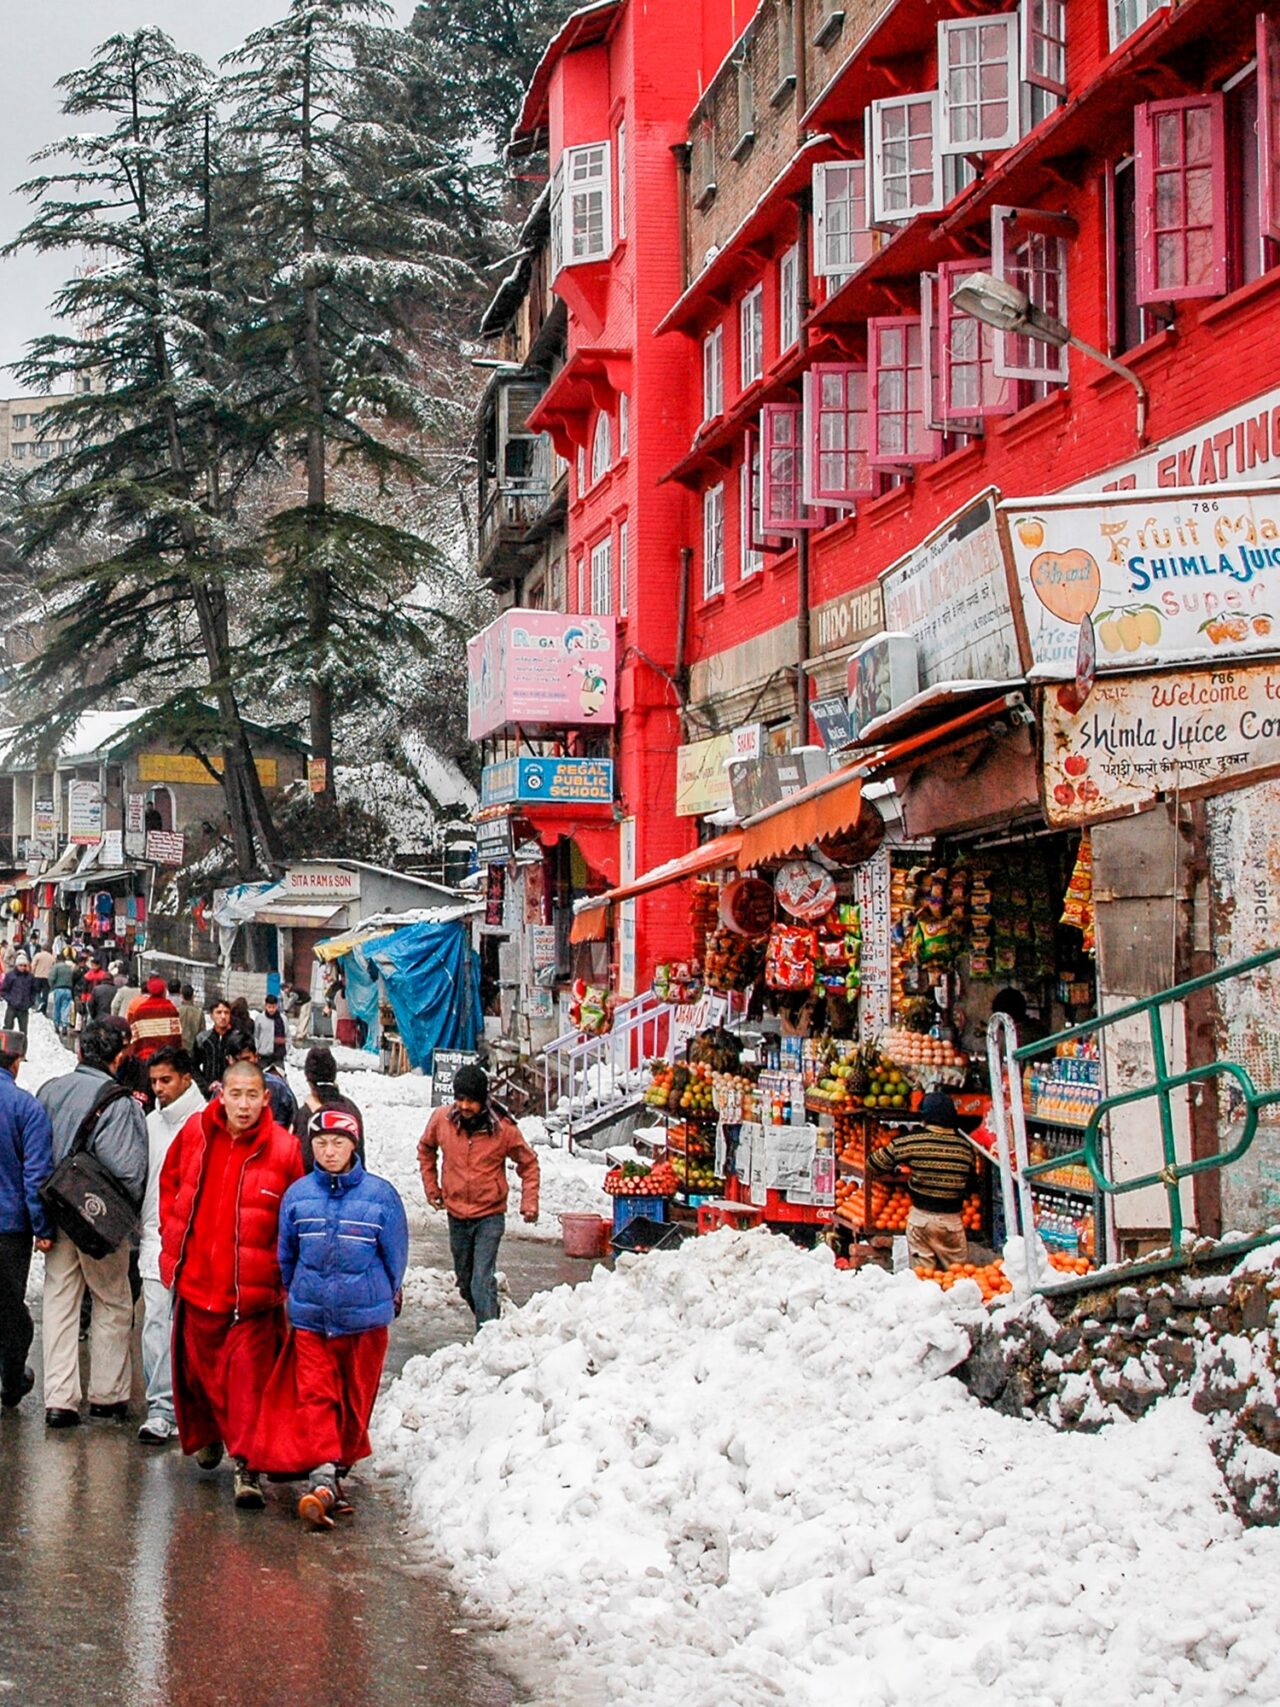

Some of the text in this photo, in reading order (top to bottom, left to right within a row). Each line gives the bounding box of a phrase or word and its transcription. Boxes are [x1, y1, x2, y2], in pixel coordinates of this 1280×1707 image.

[1192, 502, 1219, 512] 786
[1100, 516, 1200, 565] Fruit
[1128, 553, 1234, 592] SHIMLA
[1162, 583, 1266, 616] Super
[1211, 673, 1234, 685] 786
[1151, 681, 1248, 708] Welcome
[1080, 713, 1156, 755] Shimla
[1163, 716, 1227, 750] Juice
[557, 764, 608, 776] REGAL
[553, 775, 608, 786] PUBLIC
[550, 786, 608, 797] SCHOOL
[292, 875, 308, 887] SITA
[310, 875, 328, 887] RAM
[334, 876, 351, 887] SON
